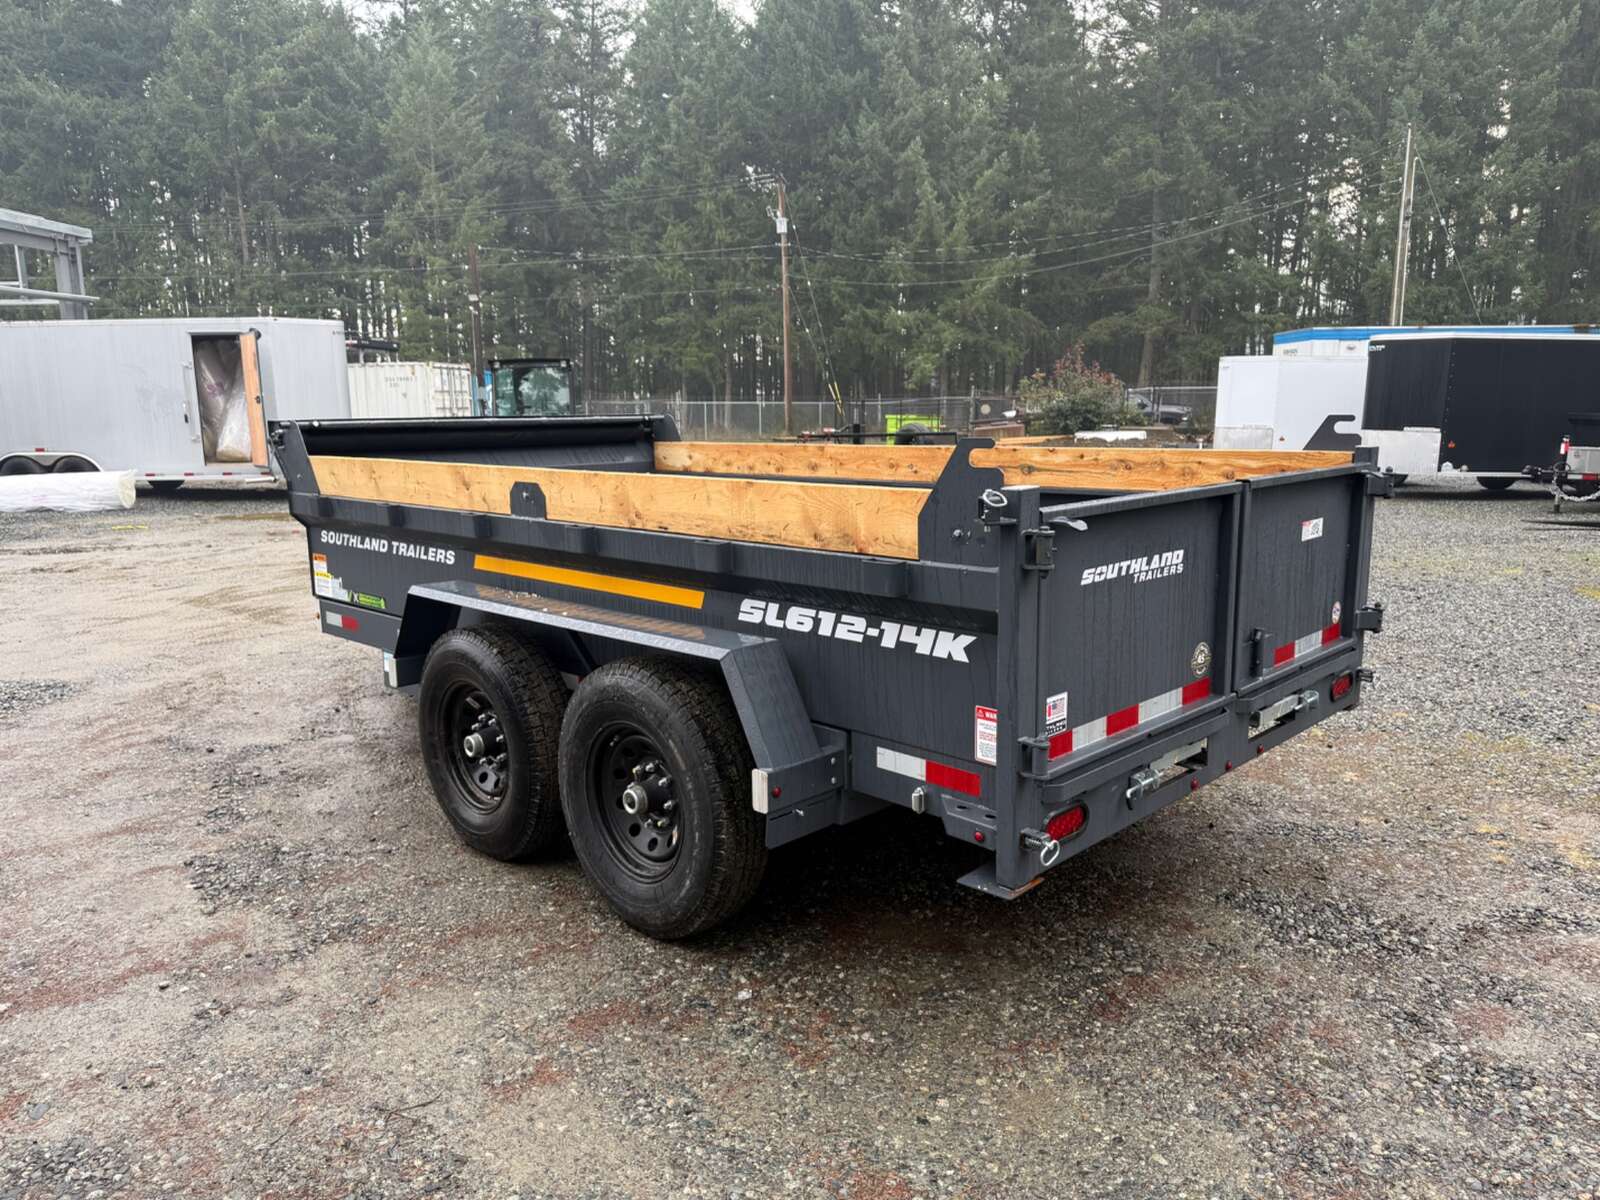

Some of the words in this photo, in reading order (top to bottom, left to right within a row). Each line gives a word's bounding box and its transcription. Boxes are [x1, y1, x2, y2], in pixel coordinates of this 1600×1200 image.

[320, 529, 388, 553] SOUTHLAND
[391, 541, 456, 565] TRAILERS
[1080, 549, 1184, 586] SOUTHLAND
[1133, 563, 1184, 584] TRAILERS
[737, 598, 978, 664] SL612-14K
